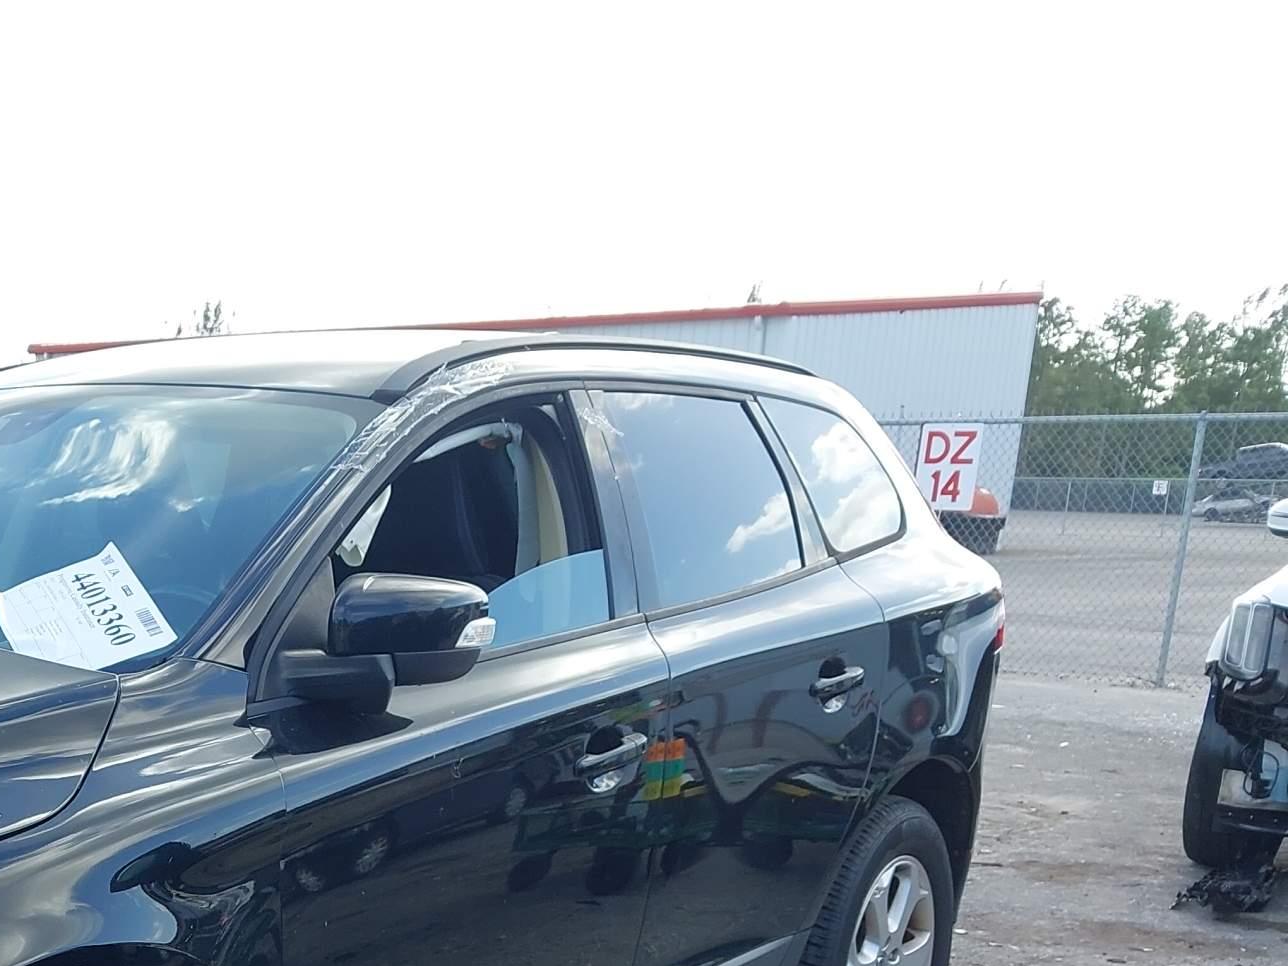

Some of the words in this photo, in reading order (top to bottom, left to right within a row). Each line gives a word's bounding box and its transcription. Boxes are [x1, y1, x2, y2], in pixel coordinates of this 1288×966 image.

[923, 430, 978, 465] DZ
[930, 469, 961, 503] 14
[71, 572, 136, 646] 44013360
